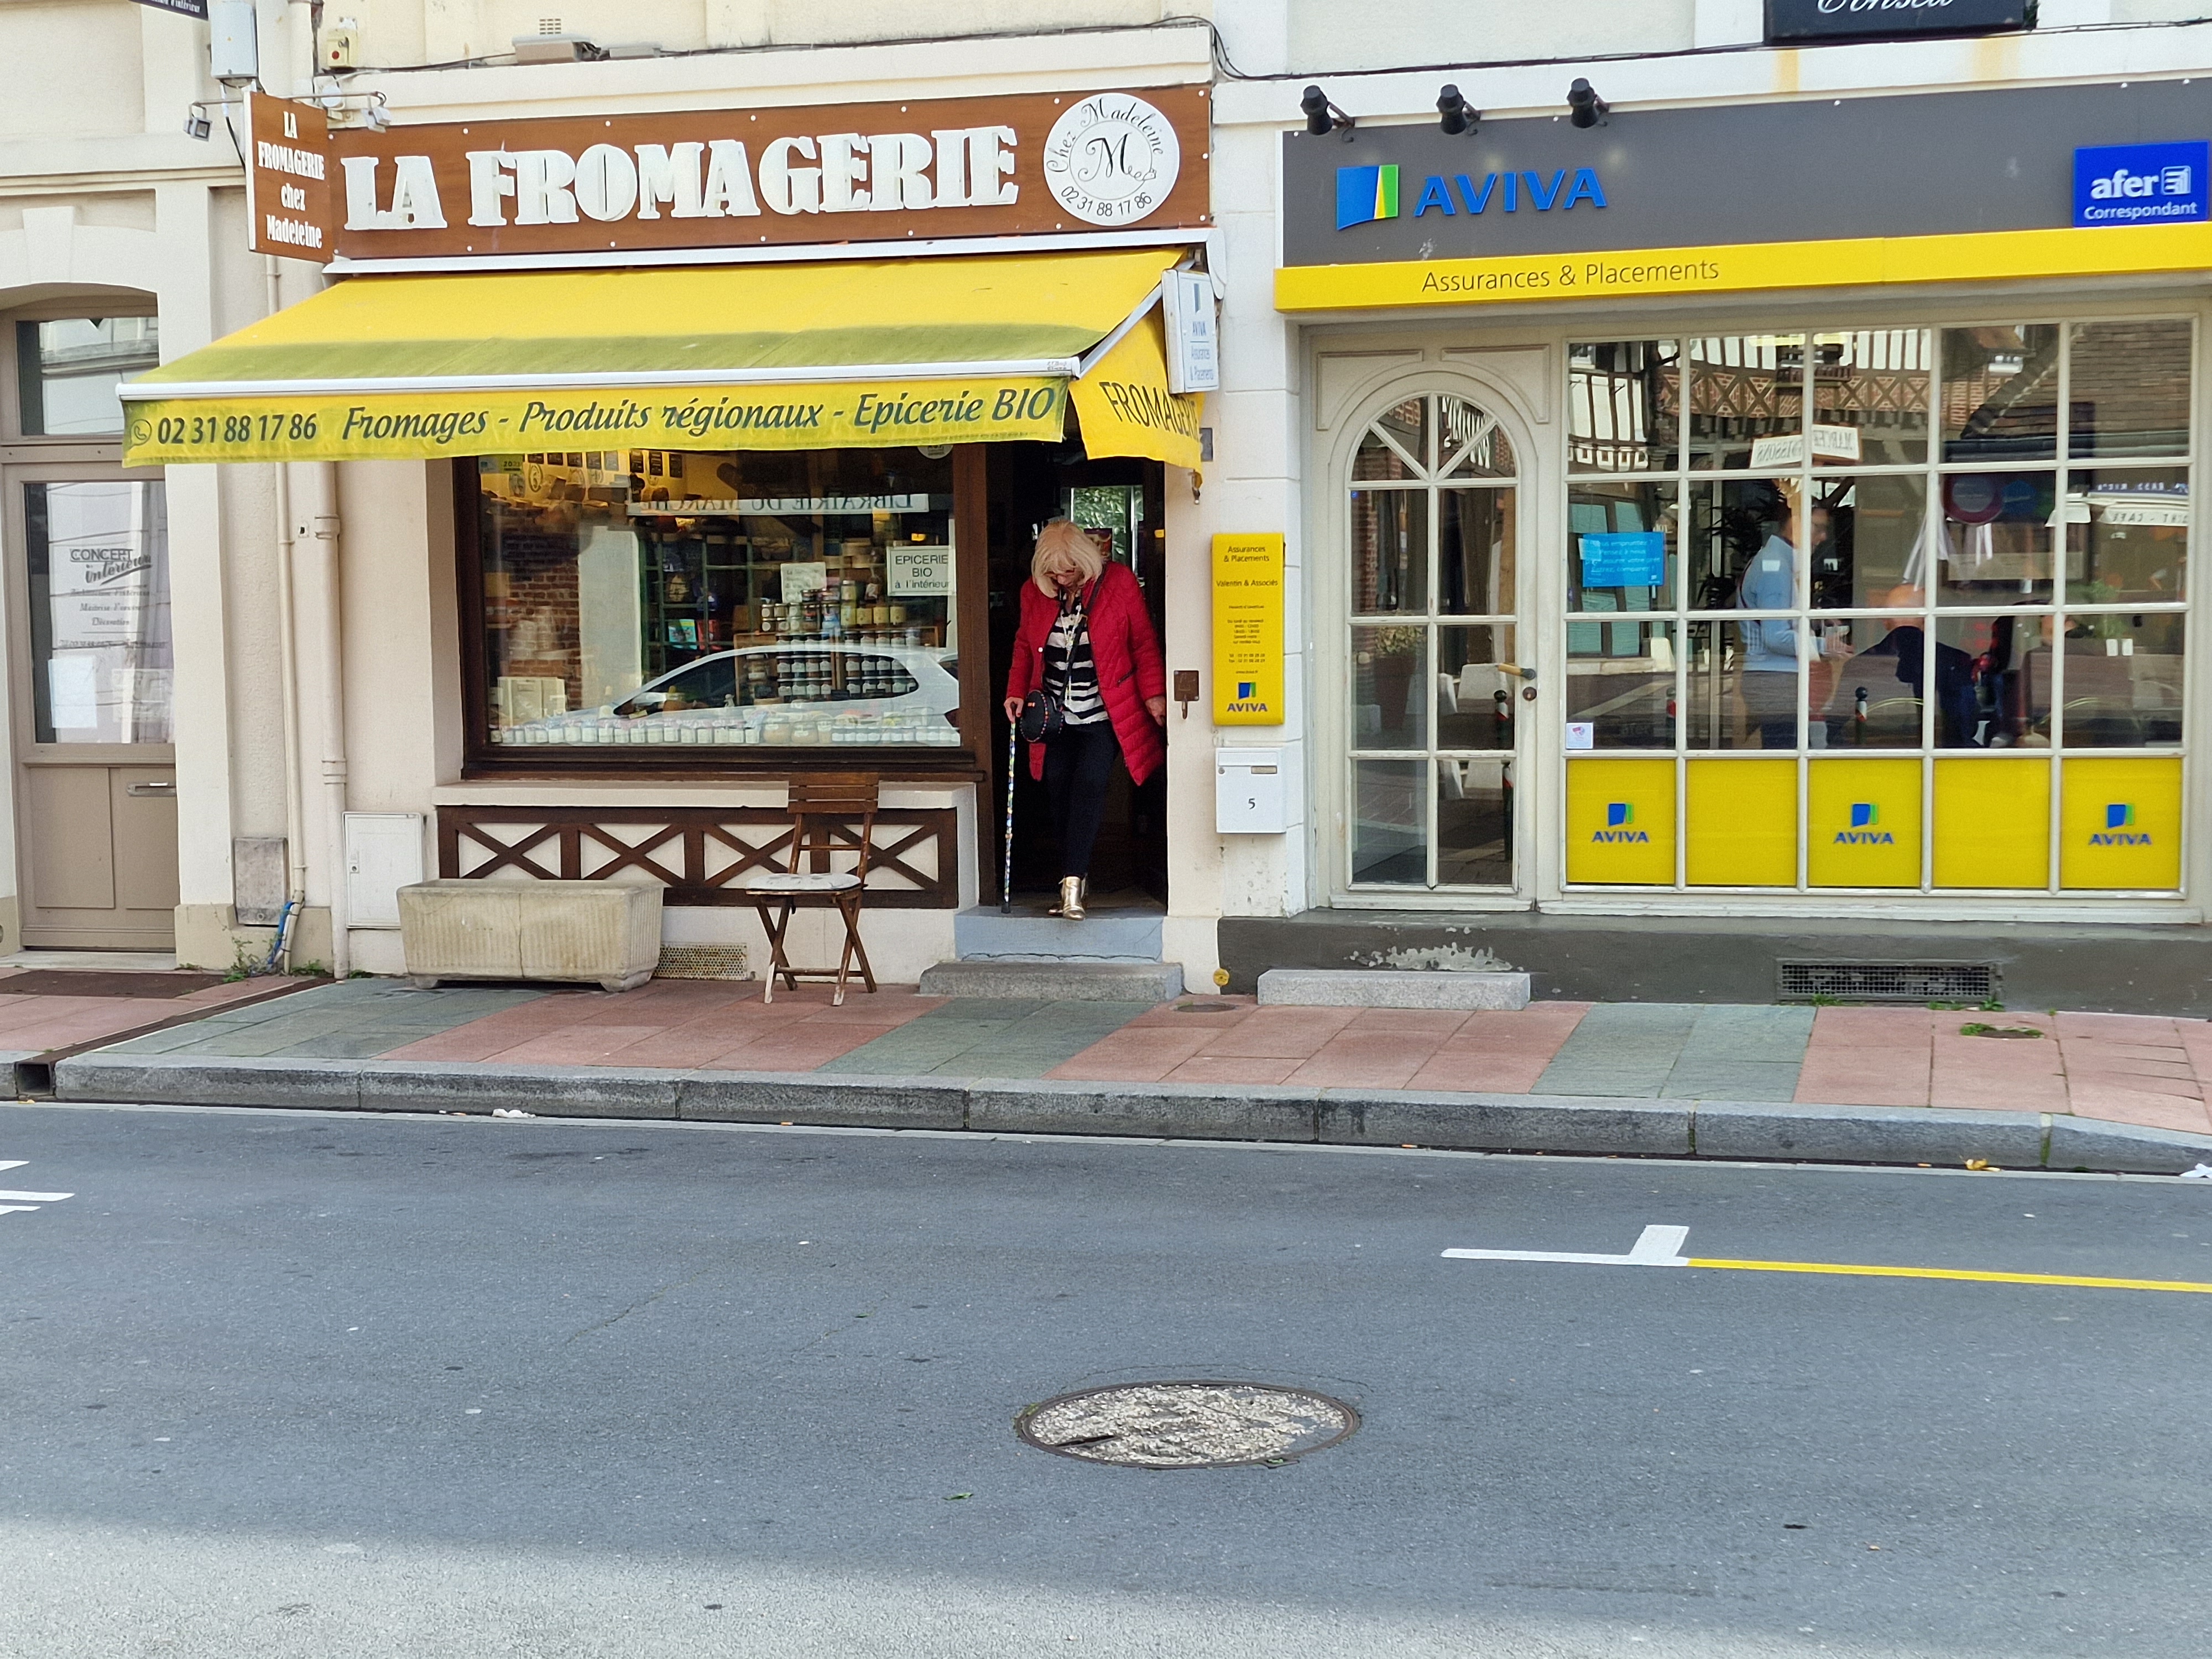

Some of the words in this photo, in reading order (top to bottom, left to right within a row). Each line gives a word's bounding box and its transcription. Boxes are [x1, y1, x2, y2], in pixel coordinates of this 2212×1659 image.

[283, 111, 298, 139] LA
[1080, 98, 1164, 155] Madeleine
[258, 141, 325, 180] FROMAGERIE
[1046, 131, 1077, 173] Chez
[341, 155, 447, 230] LA
[466, 126, 1019, 226] FROMAGERIE
[2090, 169, 2159, 199] afer
[281, 183, 306, 211] chez
[1061, 186, 1079, 204] 02
[1077, 197, 1093, 213] 31
[1097, 202, 1113, 216] 88
[1118, 200, 1131, 216] 17
[1134, 192, 1152, 208] 86
[1413, 168, 1607, 217] AVIVA
[2084, 201, 2198, 221] Correspondant
[266, 215, 322, 249] Madeleine
[1422, 273, 1550, 293] Assurances
[1558, 265, 1576, 285] &
[1585, 259, 1720, 283] Placements
[1192, 321, 1207, 337] AVIVA
[158, 417, 185, 444] 02
[190, 416, 218, 444] 31
[223, 415, 251, 443] 88
[259, 414, 284, 442] 17
[288, 413, 317, 441] 86
[342, 406, 489, 445] Fromages
[519, 399, 651, 433] Produits
[662, 397, 824, 437] régionaux
[853, 390, 983, 434] Epicerie
[991, 387, 1056, 421] BIO
[895, 555, 949, 565] EPICERIE
[912, 567, 932, 577] BIO
[1227, 703, 1268, 712] AVIVA
[1248, 797, 1256, 810] 5
[1592, 831, 1650, 843] AVIVA
[1833, 832, 1895, 844] AVIVA
[2088, 834, 2153, 846] AVIVA
